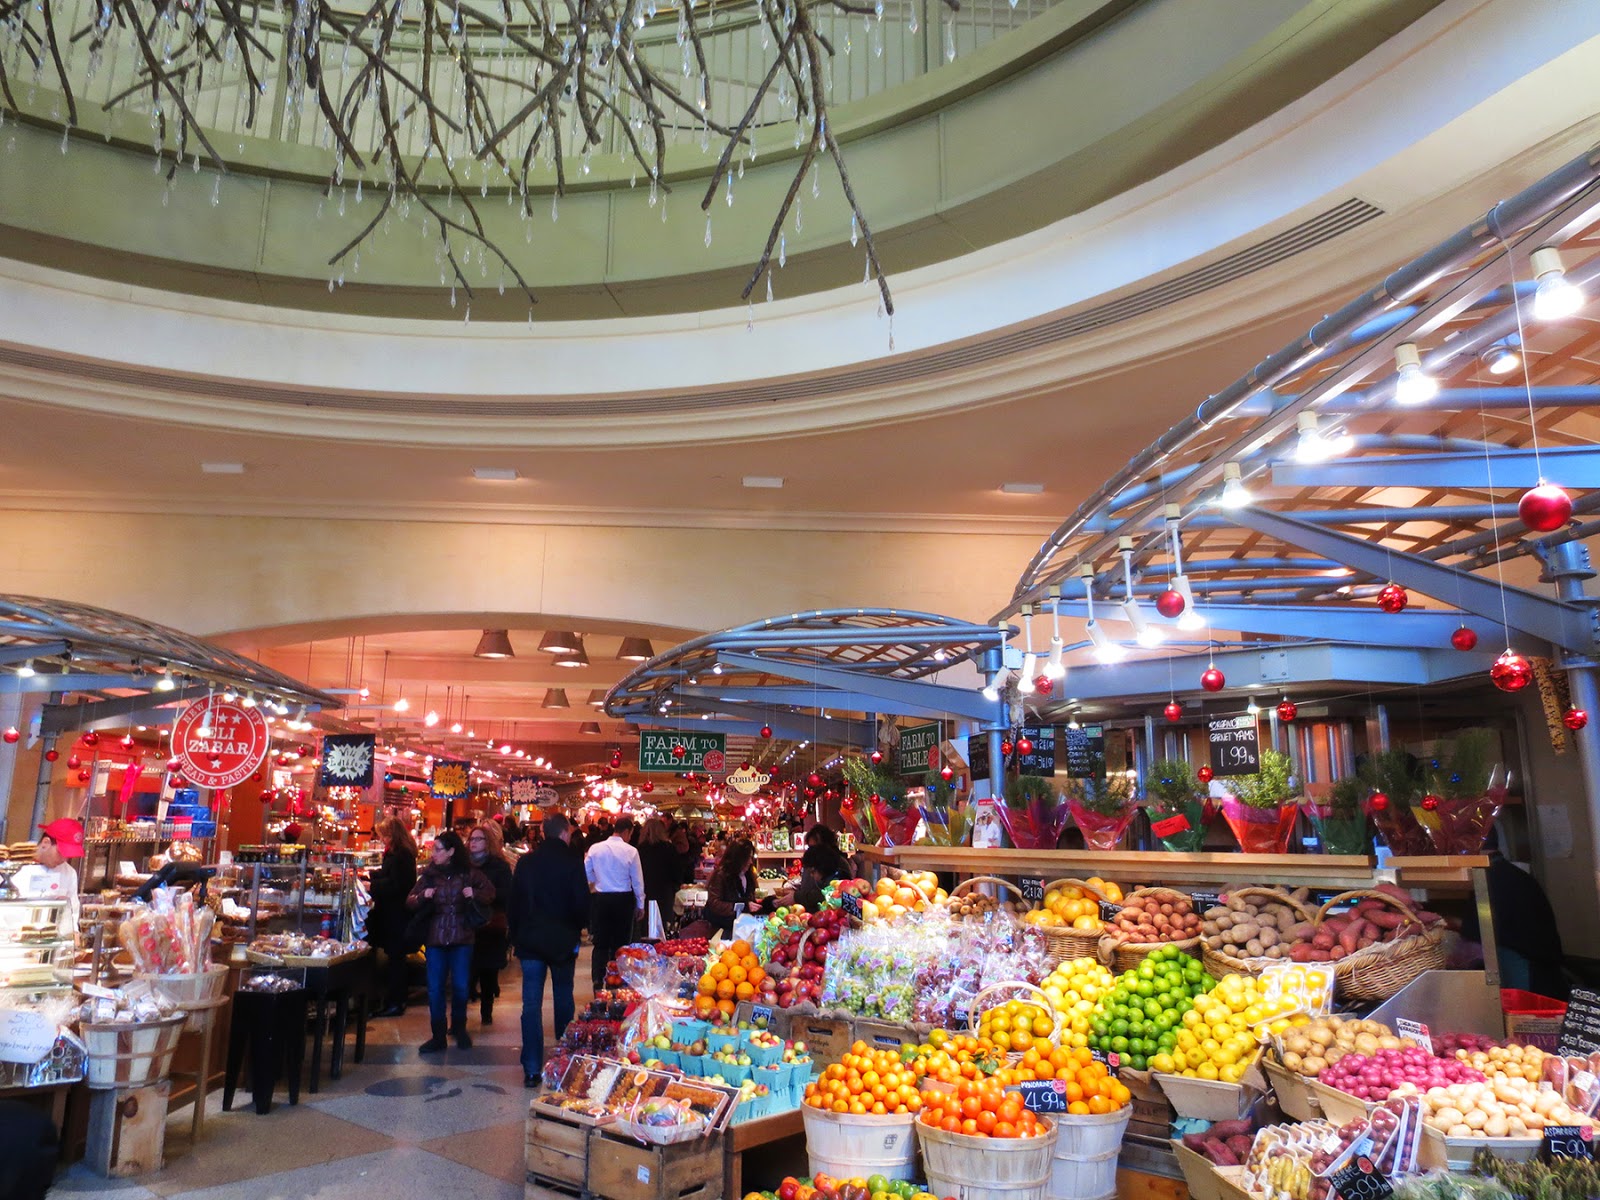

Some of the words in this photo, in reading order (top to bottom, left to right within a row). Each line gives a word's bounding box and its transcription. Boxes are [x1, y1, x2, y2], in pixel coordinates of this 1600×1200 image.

[183, 702, 204, 723] NEW
[207, 727, 236, 740] ELI
[902, 732, 926, 751] FARM
[926, 732, 936, 744] TO
[1234, 729, 1255, 741] YAMS
[188, 740, 249, 755] ZABAR
[645, 736, 697, 750] FARM
[700, 739, 718, 749] TO
[644, 752, 703, 766] TABLE
[902, 750, 929, 768] TABLE
[1221, 746, 1248, 767] 1.99
[178, 752, 205, 781] BREAD
[207, 776, 217, 785] &
[221, 753, 260, 785] PASTRY
